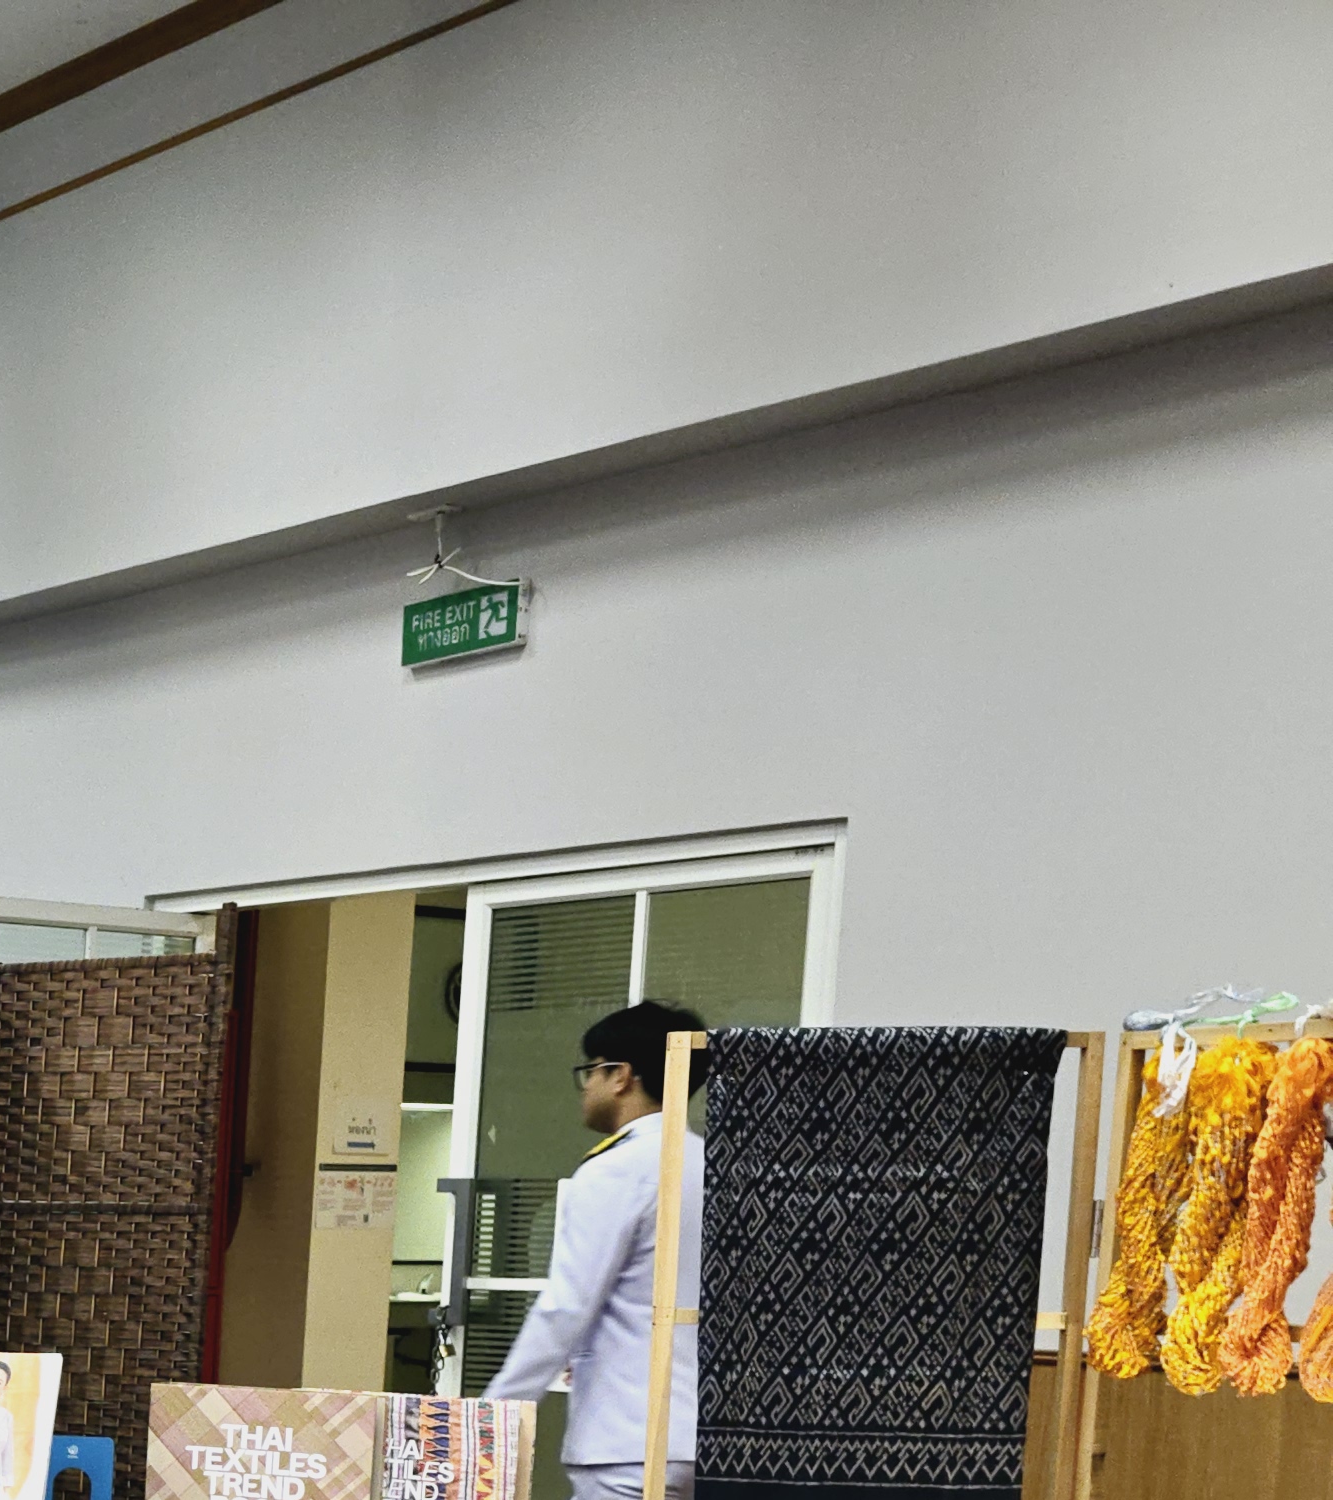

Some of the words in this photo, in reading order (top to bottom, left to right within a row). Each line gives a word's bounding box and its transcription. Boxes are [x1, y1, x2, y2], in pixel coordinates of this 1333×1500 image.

[412, 609, 441, 633] FIRE
[445, 600, 477, 625] EXIT
[417, 623, 470, 651] ทางออก
[220, 1423, 293, 1452] THAI
[386, 1438, 424, 1460] HAI
[185, 1445, 327, 1479] TEXTILES
[203, 1470, 305, 1500] TREND
